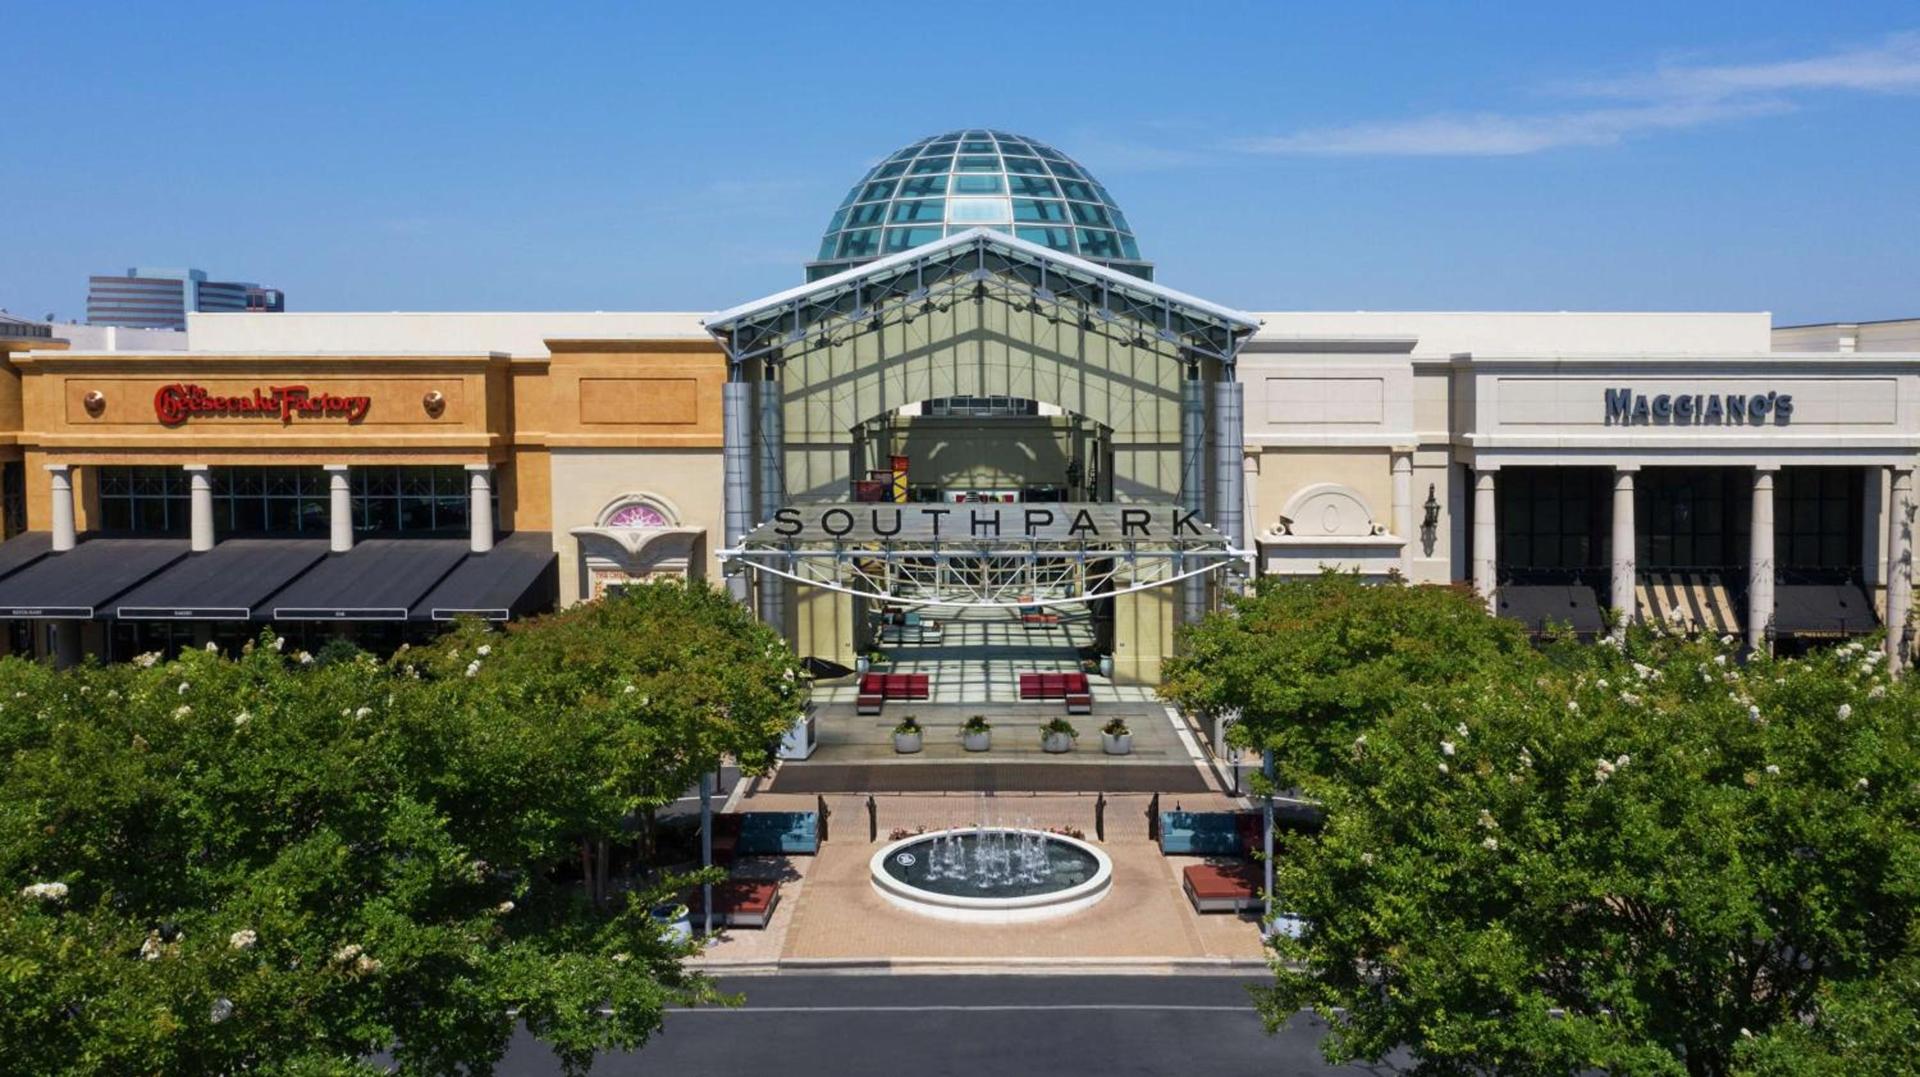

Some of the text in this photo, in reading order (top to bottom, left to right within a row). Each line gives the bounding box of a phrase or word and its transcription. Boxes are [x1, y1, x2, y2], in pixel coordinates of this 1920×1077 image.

[154, 384, 371, 426] Cheesecake Factory
[1605, 388, 1793, 420] MAGGIANO'S
[774, 508, 1202, 537] SOUTHPARK
